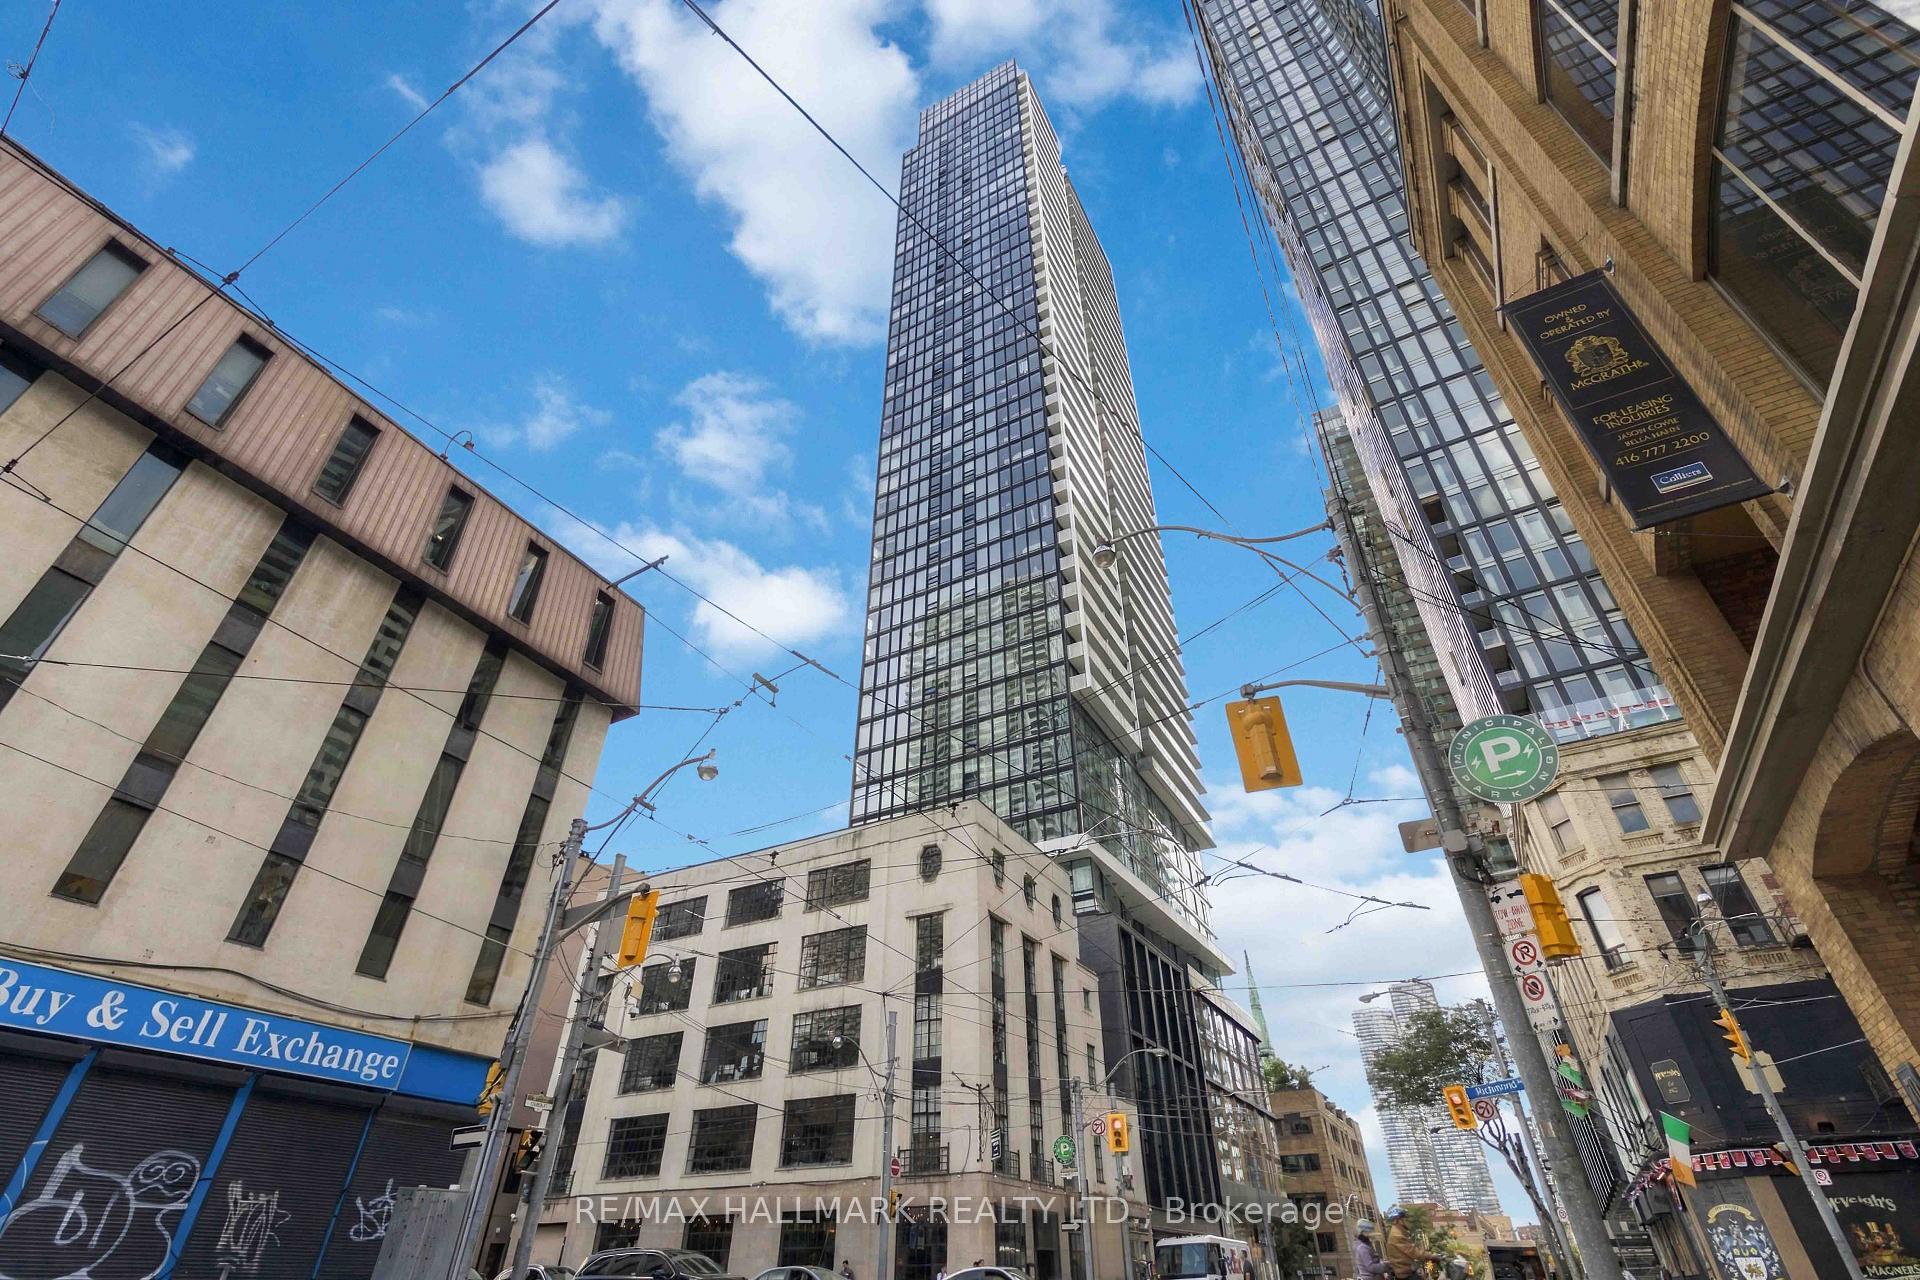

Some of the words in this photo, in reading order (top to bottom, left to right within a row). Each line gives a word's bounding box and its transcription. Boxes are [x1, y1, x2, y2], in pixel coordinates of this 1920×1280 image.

[1540, 315, 1595, 339] OPERATED
[1596, 308, 1610, 319] BY
[1544, 304, 1587, 323] OWNED
[1592, 411, 1620, 425] FOR
[1620, 394, 1673, 416] LEASING
[1605, 404, 1671, 430] INQUIRIES
[1617, 427, 1646, 441] JASON
[1616, 453, 1640, 466] 416
[1641, 444, 1666, 457] 777
[1672, 431, 1710, 449] 2200
[1659, 469, 1702, 484] Colliers
[1454, 719, 1546, 765] MUNICIPAL
[1479, 736, 1521, 774] P
[1462, 755, 1554, 799] PARKING
[1506, 918, 1525, 931] ZONE
[0, 967, 76, 1025] Buy
[86, 990, 128, 1031] &
[139, 1000, 228, 1048] Sell
[232, 1017, 399, 1081] Exchange
[1475, 1080, 1517, 1096] Richmond
[1865, 1263, 1920, 1277] MAGNERS
